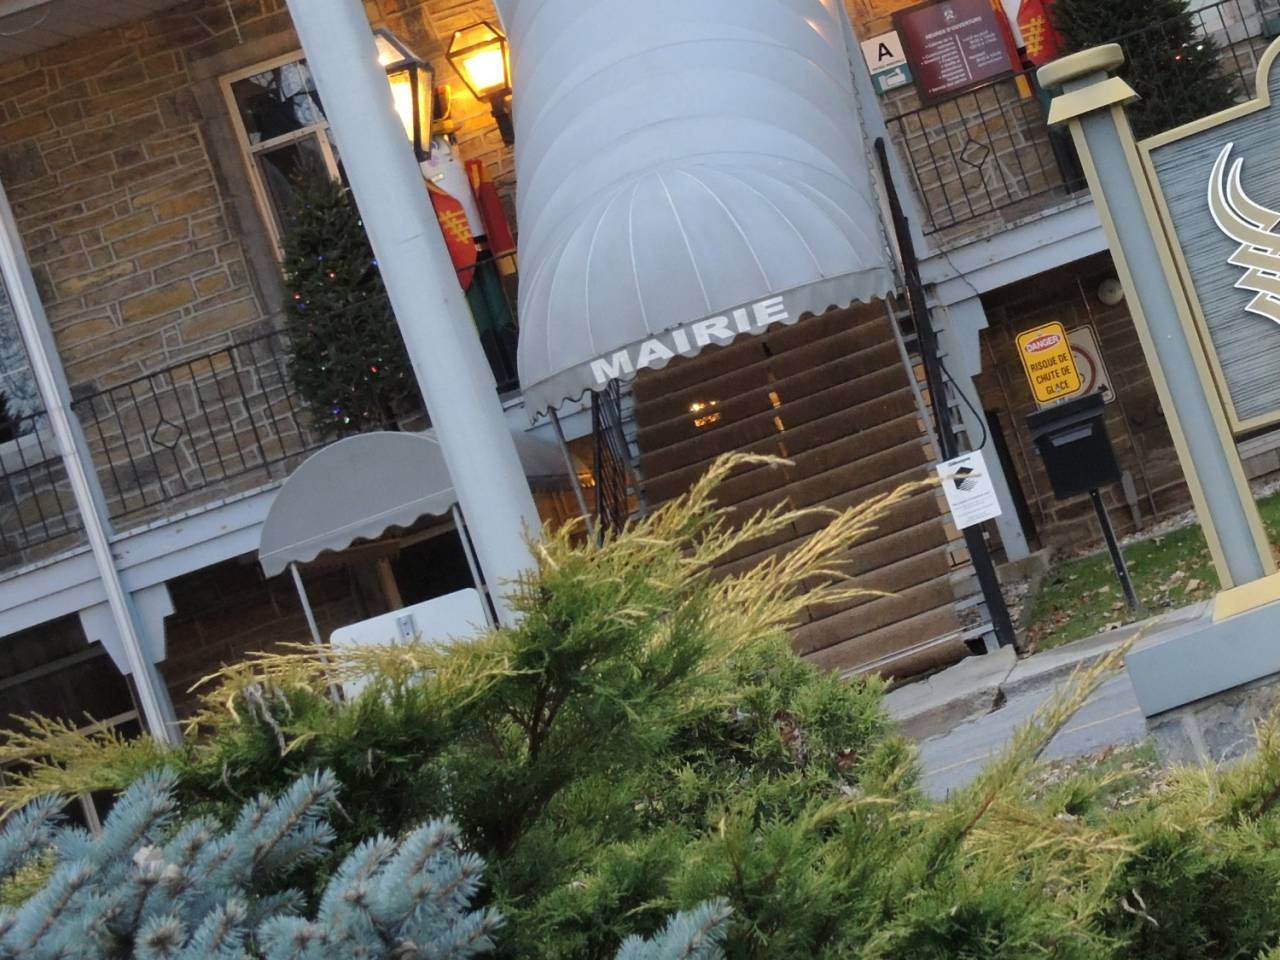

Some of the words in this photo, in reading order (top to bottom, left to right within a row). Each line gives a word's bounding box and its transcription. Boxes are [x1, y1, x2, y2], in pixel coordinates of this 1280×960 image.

[878, 42, 894, 62] A
[589, 296, 789, 385] MAIRIE
[1026, 335, 1059, 352] DANGER
[1030, 357, 1058, 373] RISQUE
[1058, 352, 1069, 363] DE
[1035, 369, 1060, 385] CHUTE
[1061, 365, 1072, 376] DE
[1045, 380, 1069, 395] GLACE
